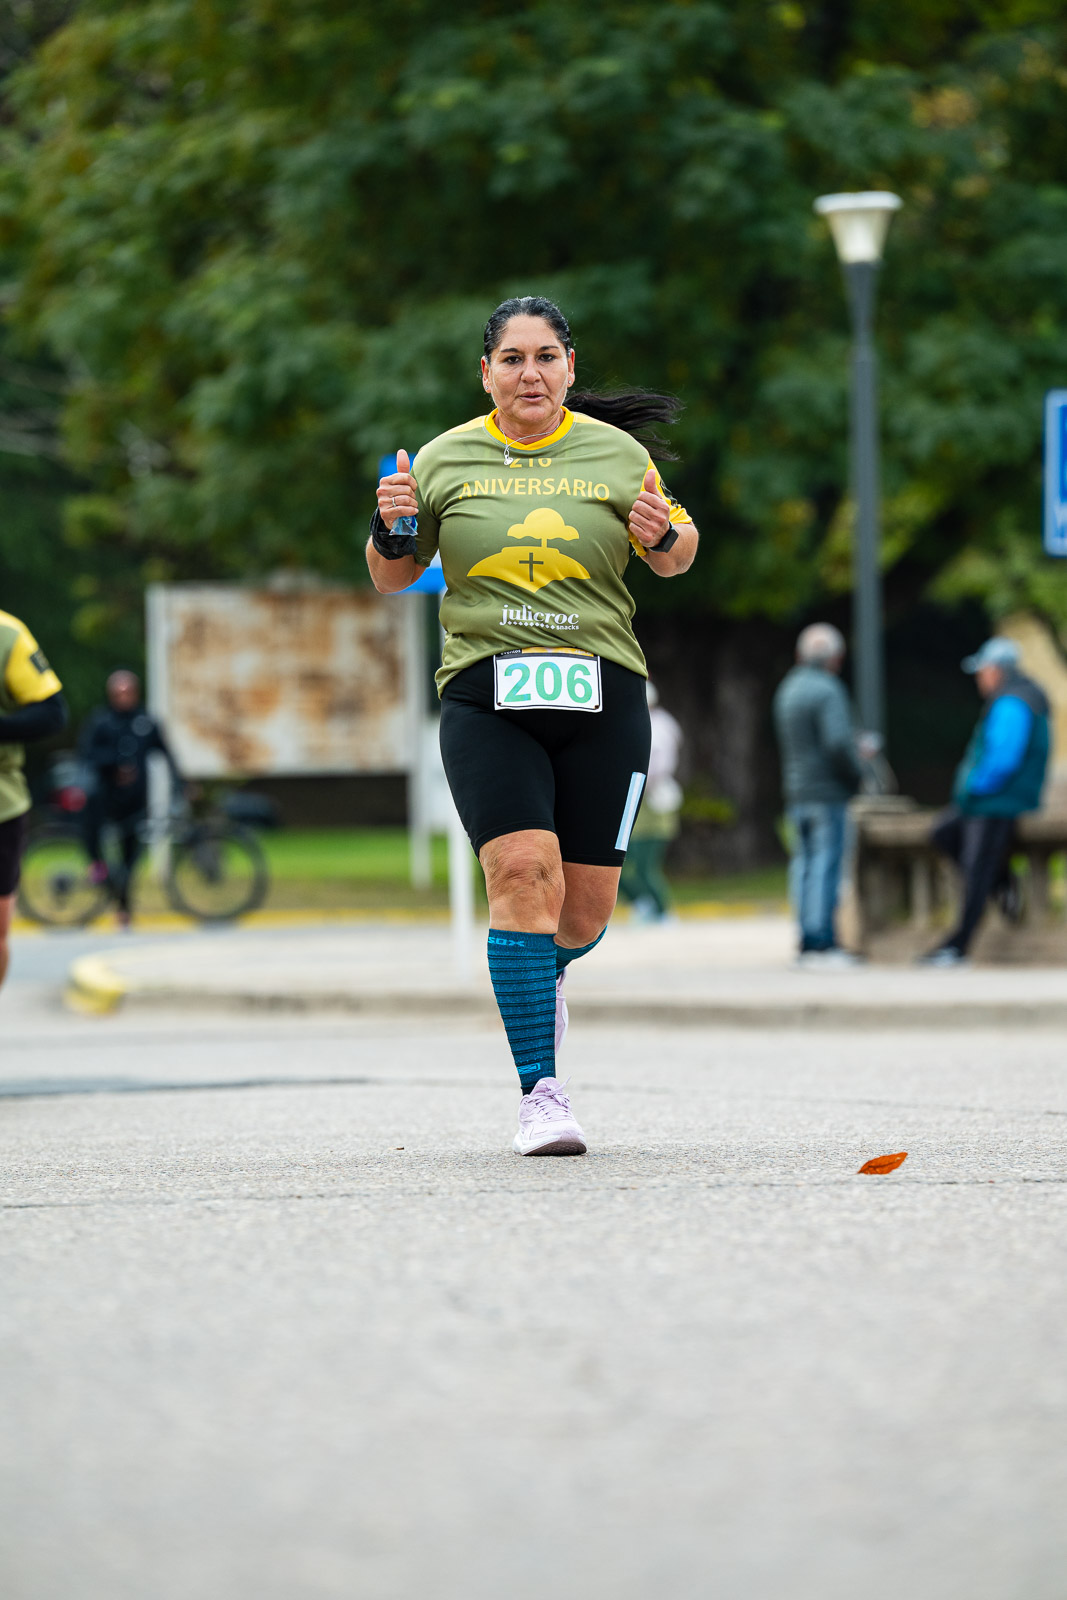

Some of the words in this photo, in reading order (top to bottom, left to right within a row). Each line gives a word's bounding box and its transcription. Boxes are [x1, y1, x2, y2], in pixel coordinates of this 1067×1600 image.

[459, 478, 610, 501] ANIVERSARIO
[499, 604, 580, 626] julicroc
[504, 662, 593, 704] 206
